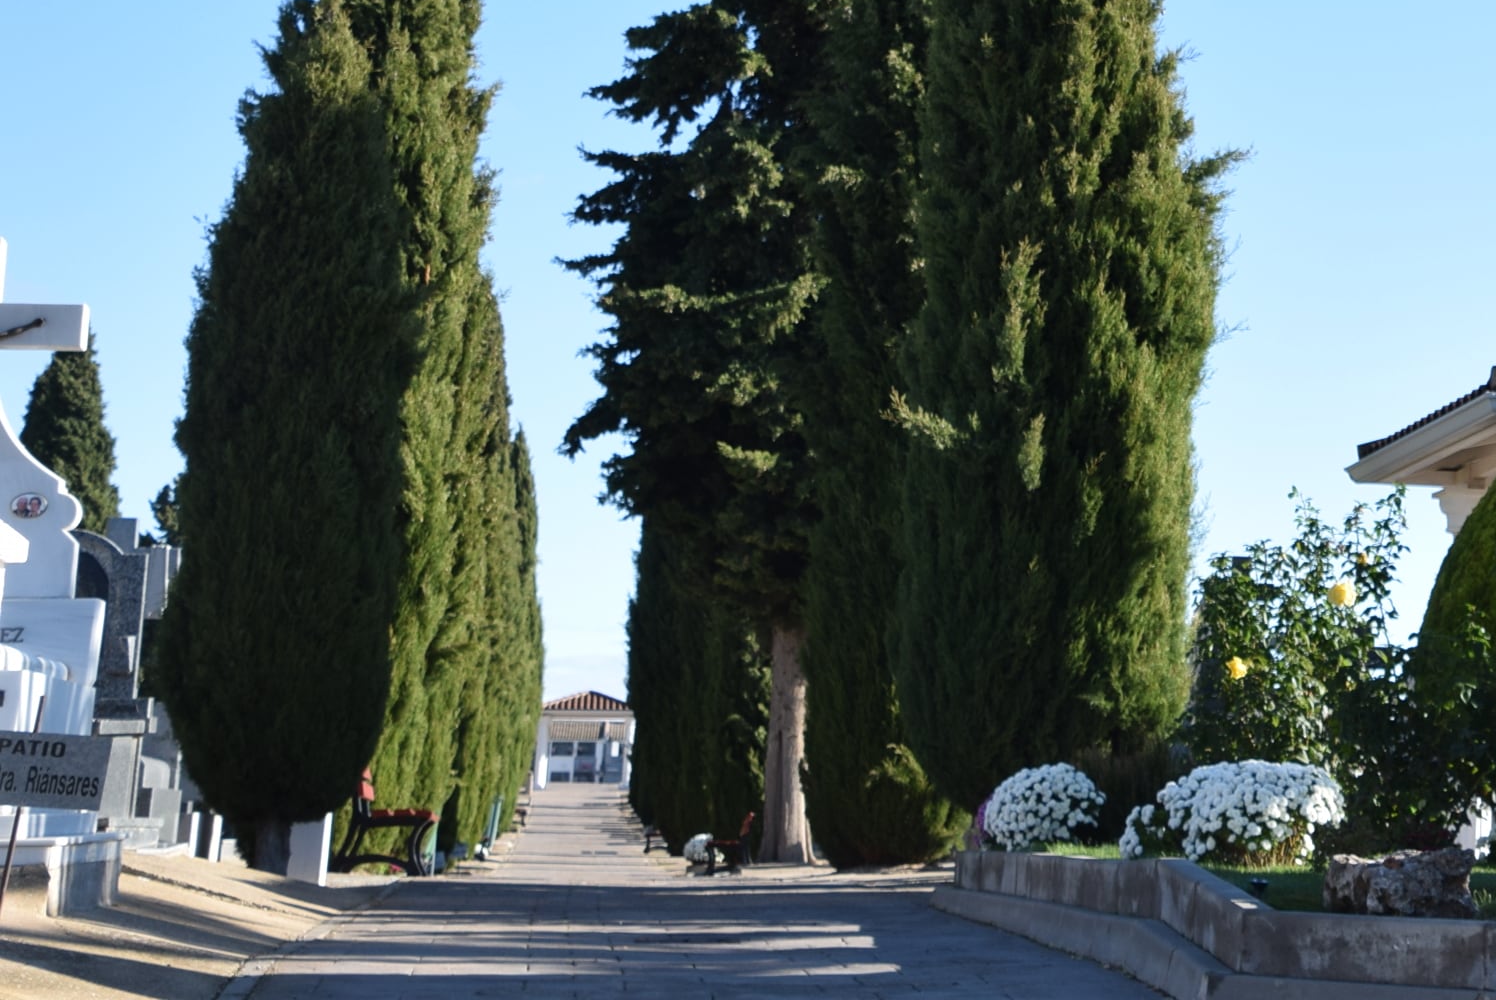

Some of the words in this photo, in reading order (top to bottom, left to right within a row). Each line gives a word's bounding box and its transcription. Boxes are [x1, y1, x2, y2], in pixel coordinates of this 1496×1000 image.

[0, 738, 66, 758] PATIO
[0, 765, 17, 792] ra.
[25, 766, 99, 797] Riánsares
